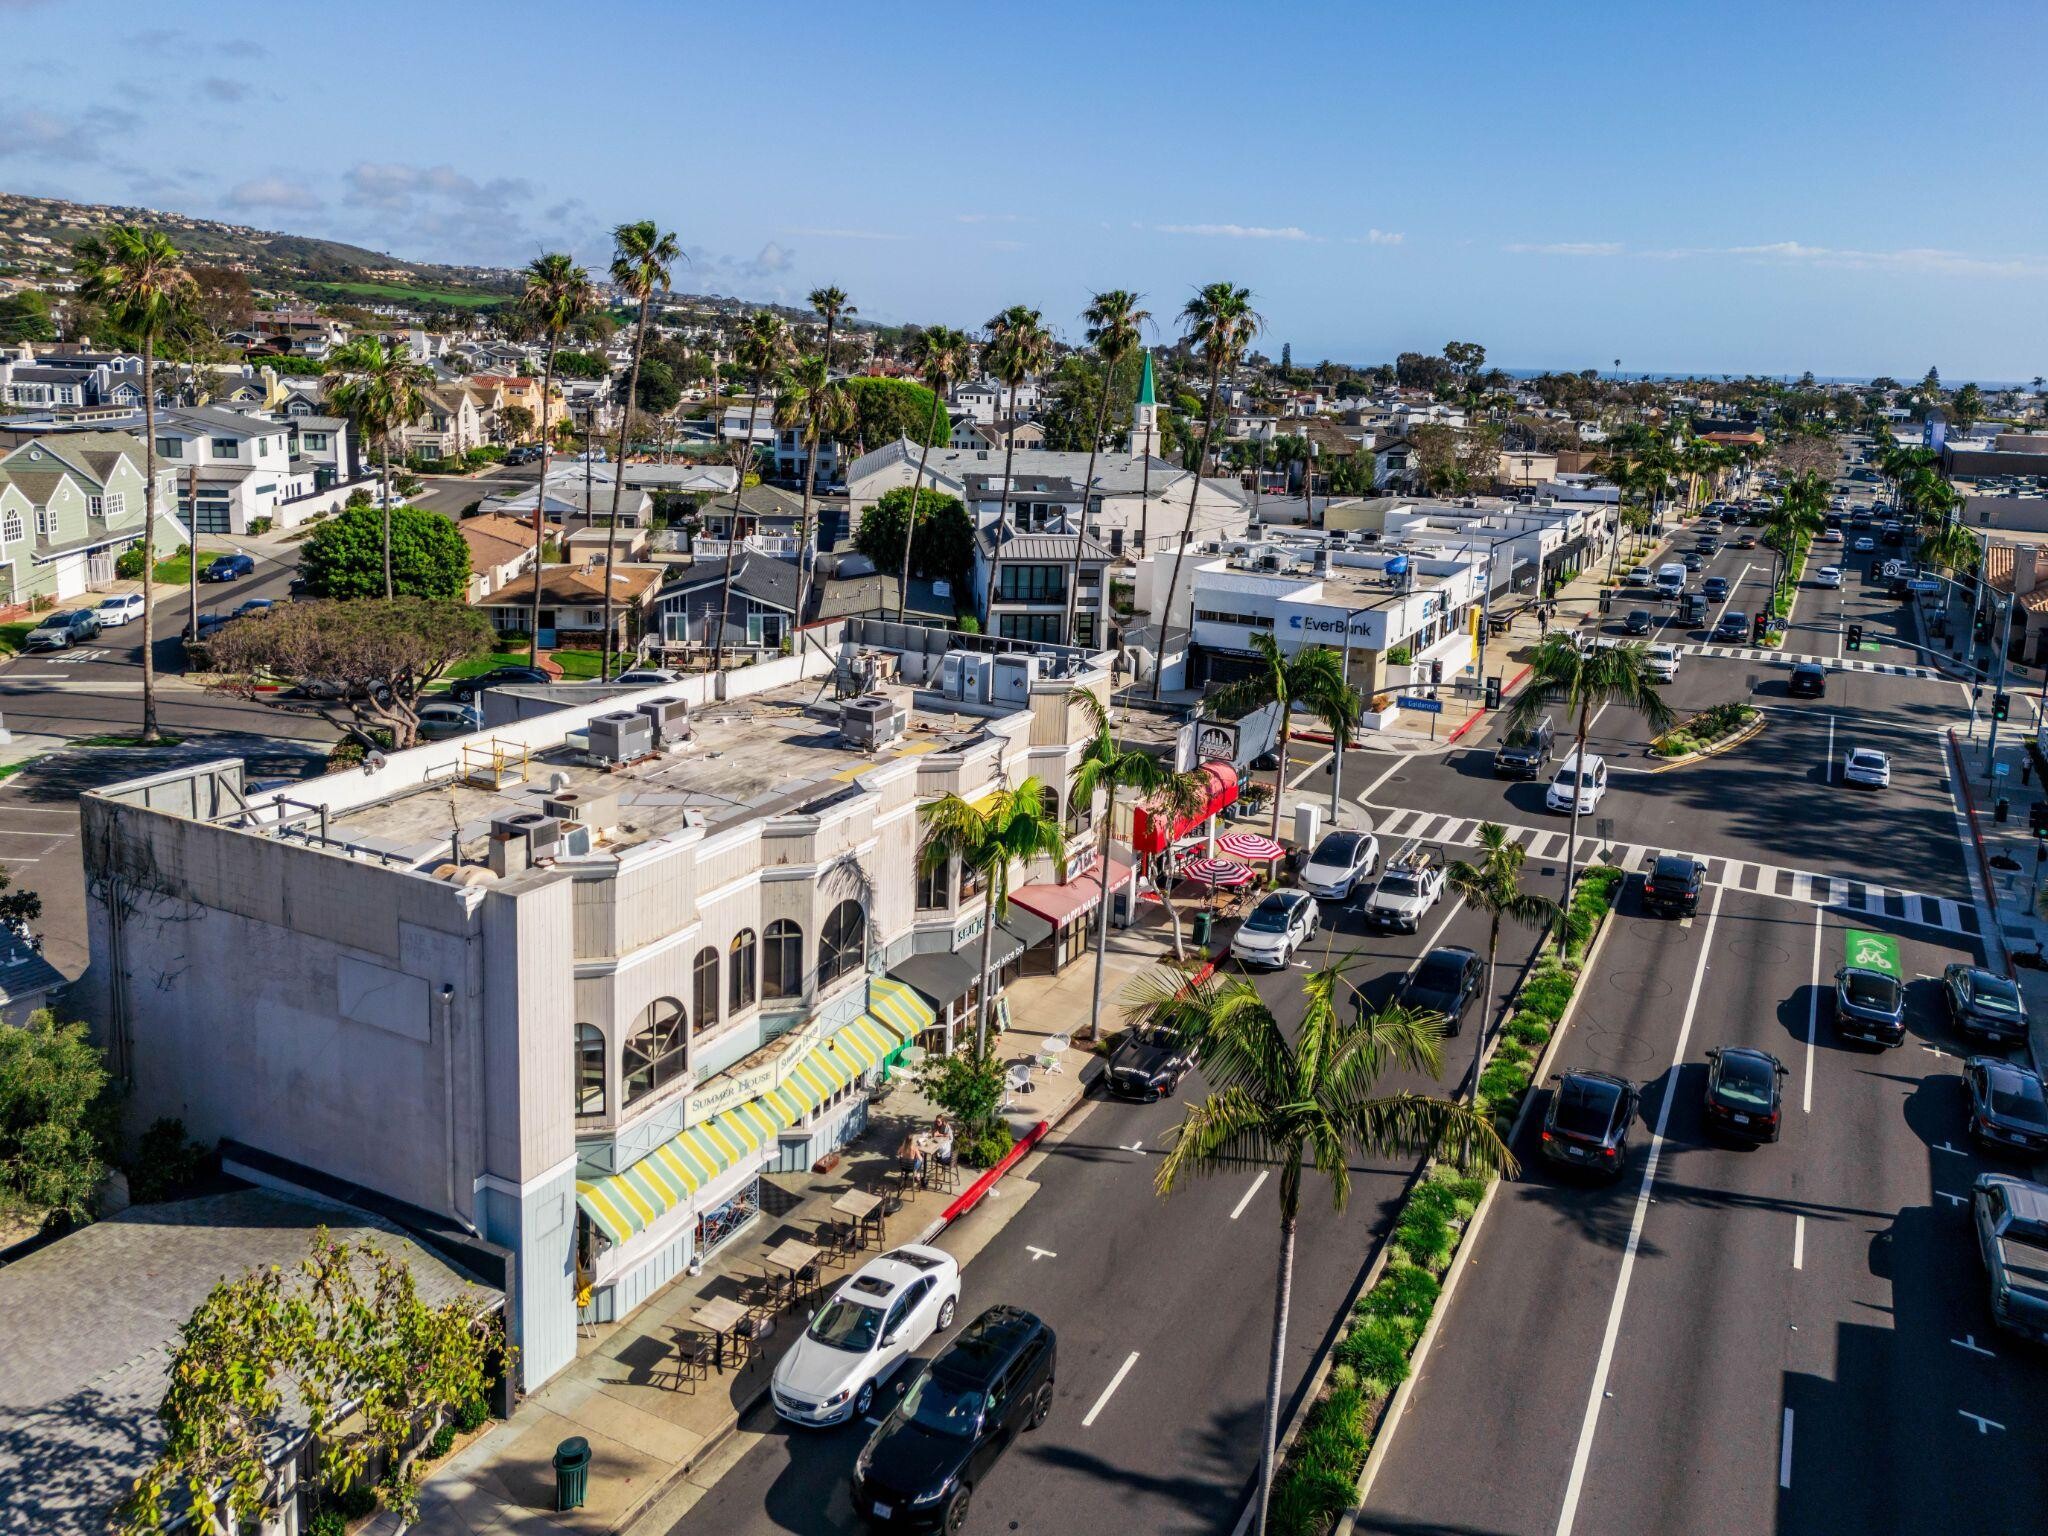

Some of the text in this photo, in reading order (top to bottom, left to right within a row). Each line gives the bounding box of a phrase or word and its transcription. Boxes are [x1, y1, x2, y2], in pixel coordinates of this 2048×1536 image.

[1305, 617, 1372, 637] EverBank
[1198, 746, 1232, 760] PIZZA
[1061, 893, 1100, 927] HAPPY NAILS
[971, 959, 1000, 985] supood
[692, 1071, 772, 1112] SUMMER HOUSE
